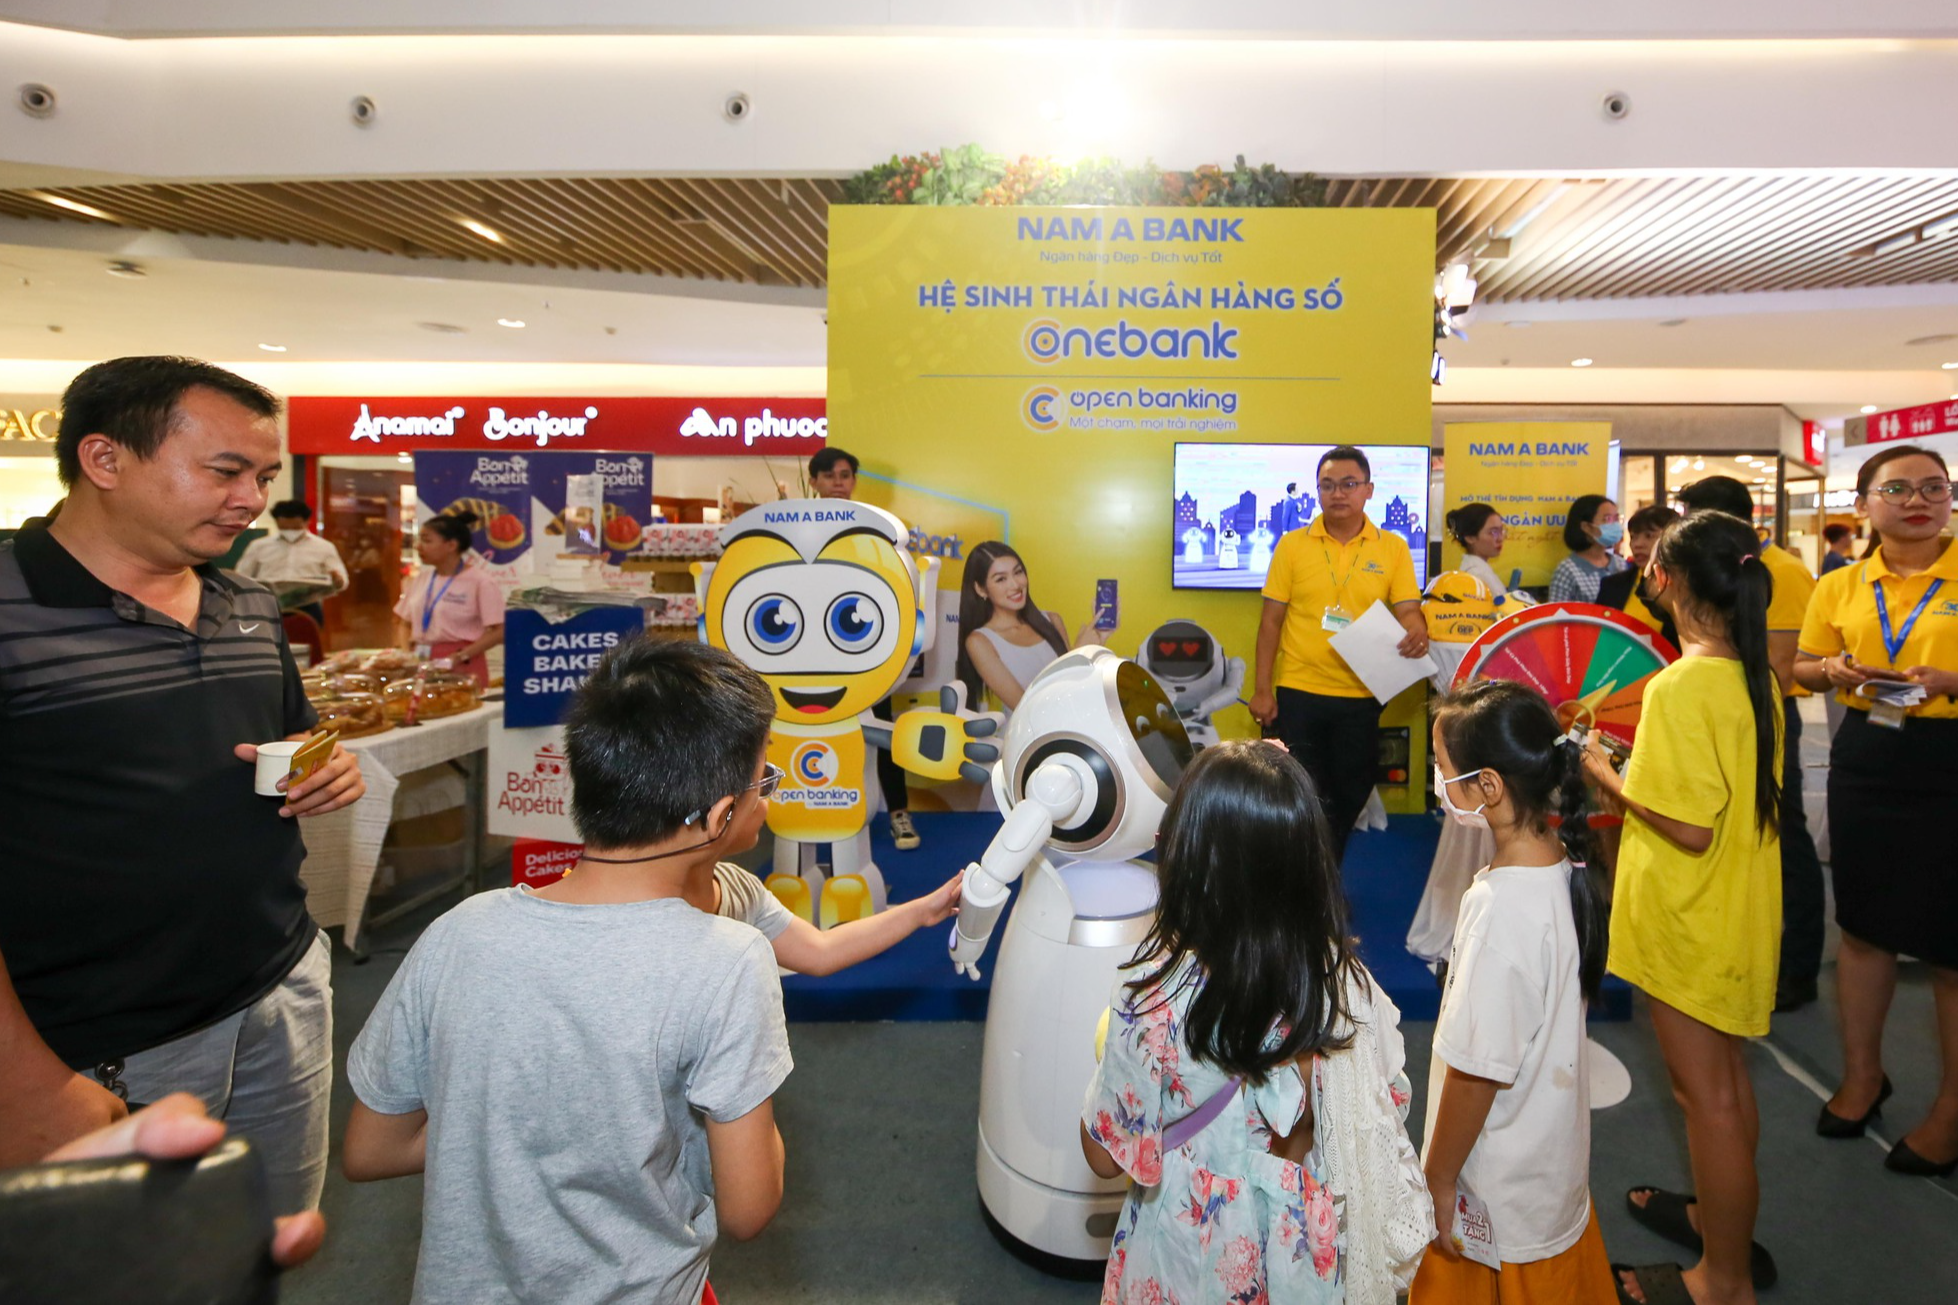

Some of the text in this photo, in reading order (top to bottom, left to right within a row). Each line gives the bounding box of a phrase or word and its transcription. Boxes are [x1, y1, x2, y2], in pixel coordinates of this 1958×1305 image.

[1018, 217, 1244, 242] NAM A BANK
[1040, 251, 1074, 264] Ngân
[1078, 251, 1109, 264] hàng
[1113, 251, 1139, 264] Đẹp
[1151, 251, 1180, 264] Dịch
[1184, 254, 1198, 264] vụ
[1203, 250, 1223, 263] Tốt
[919, 277, 1343, 313] HỆ SINH THÁI NGÂN HÀNG SỐ
[1070, 388, 1237, 414] open banking
[350, 404, 465, 443] Anamai
[483, 406, 598, 446] Bonjour
[680, 407, 737, 437] An
[1070, 417, 1236, 431] Một chạm, mọi trải nghiệm
[1469, 442, 1589, 455] NAM A BANK
[765, 510, 855, 523] NAM A BANK
[532, 632, 619, 651] CAKES
[523, 675, 589, 694] SHA
[498, 791, 564, 816] Appétit
[807, 788, 857, 802] banking
[1461, 1210, 1484, 1227] MUA 2
[1485, 1221, 1492, 1244] 1
